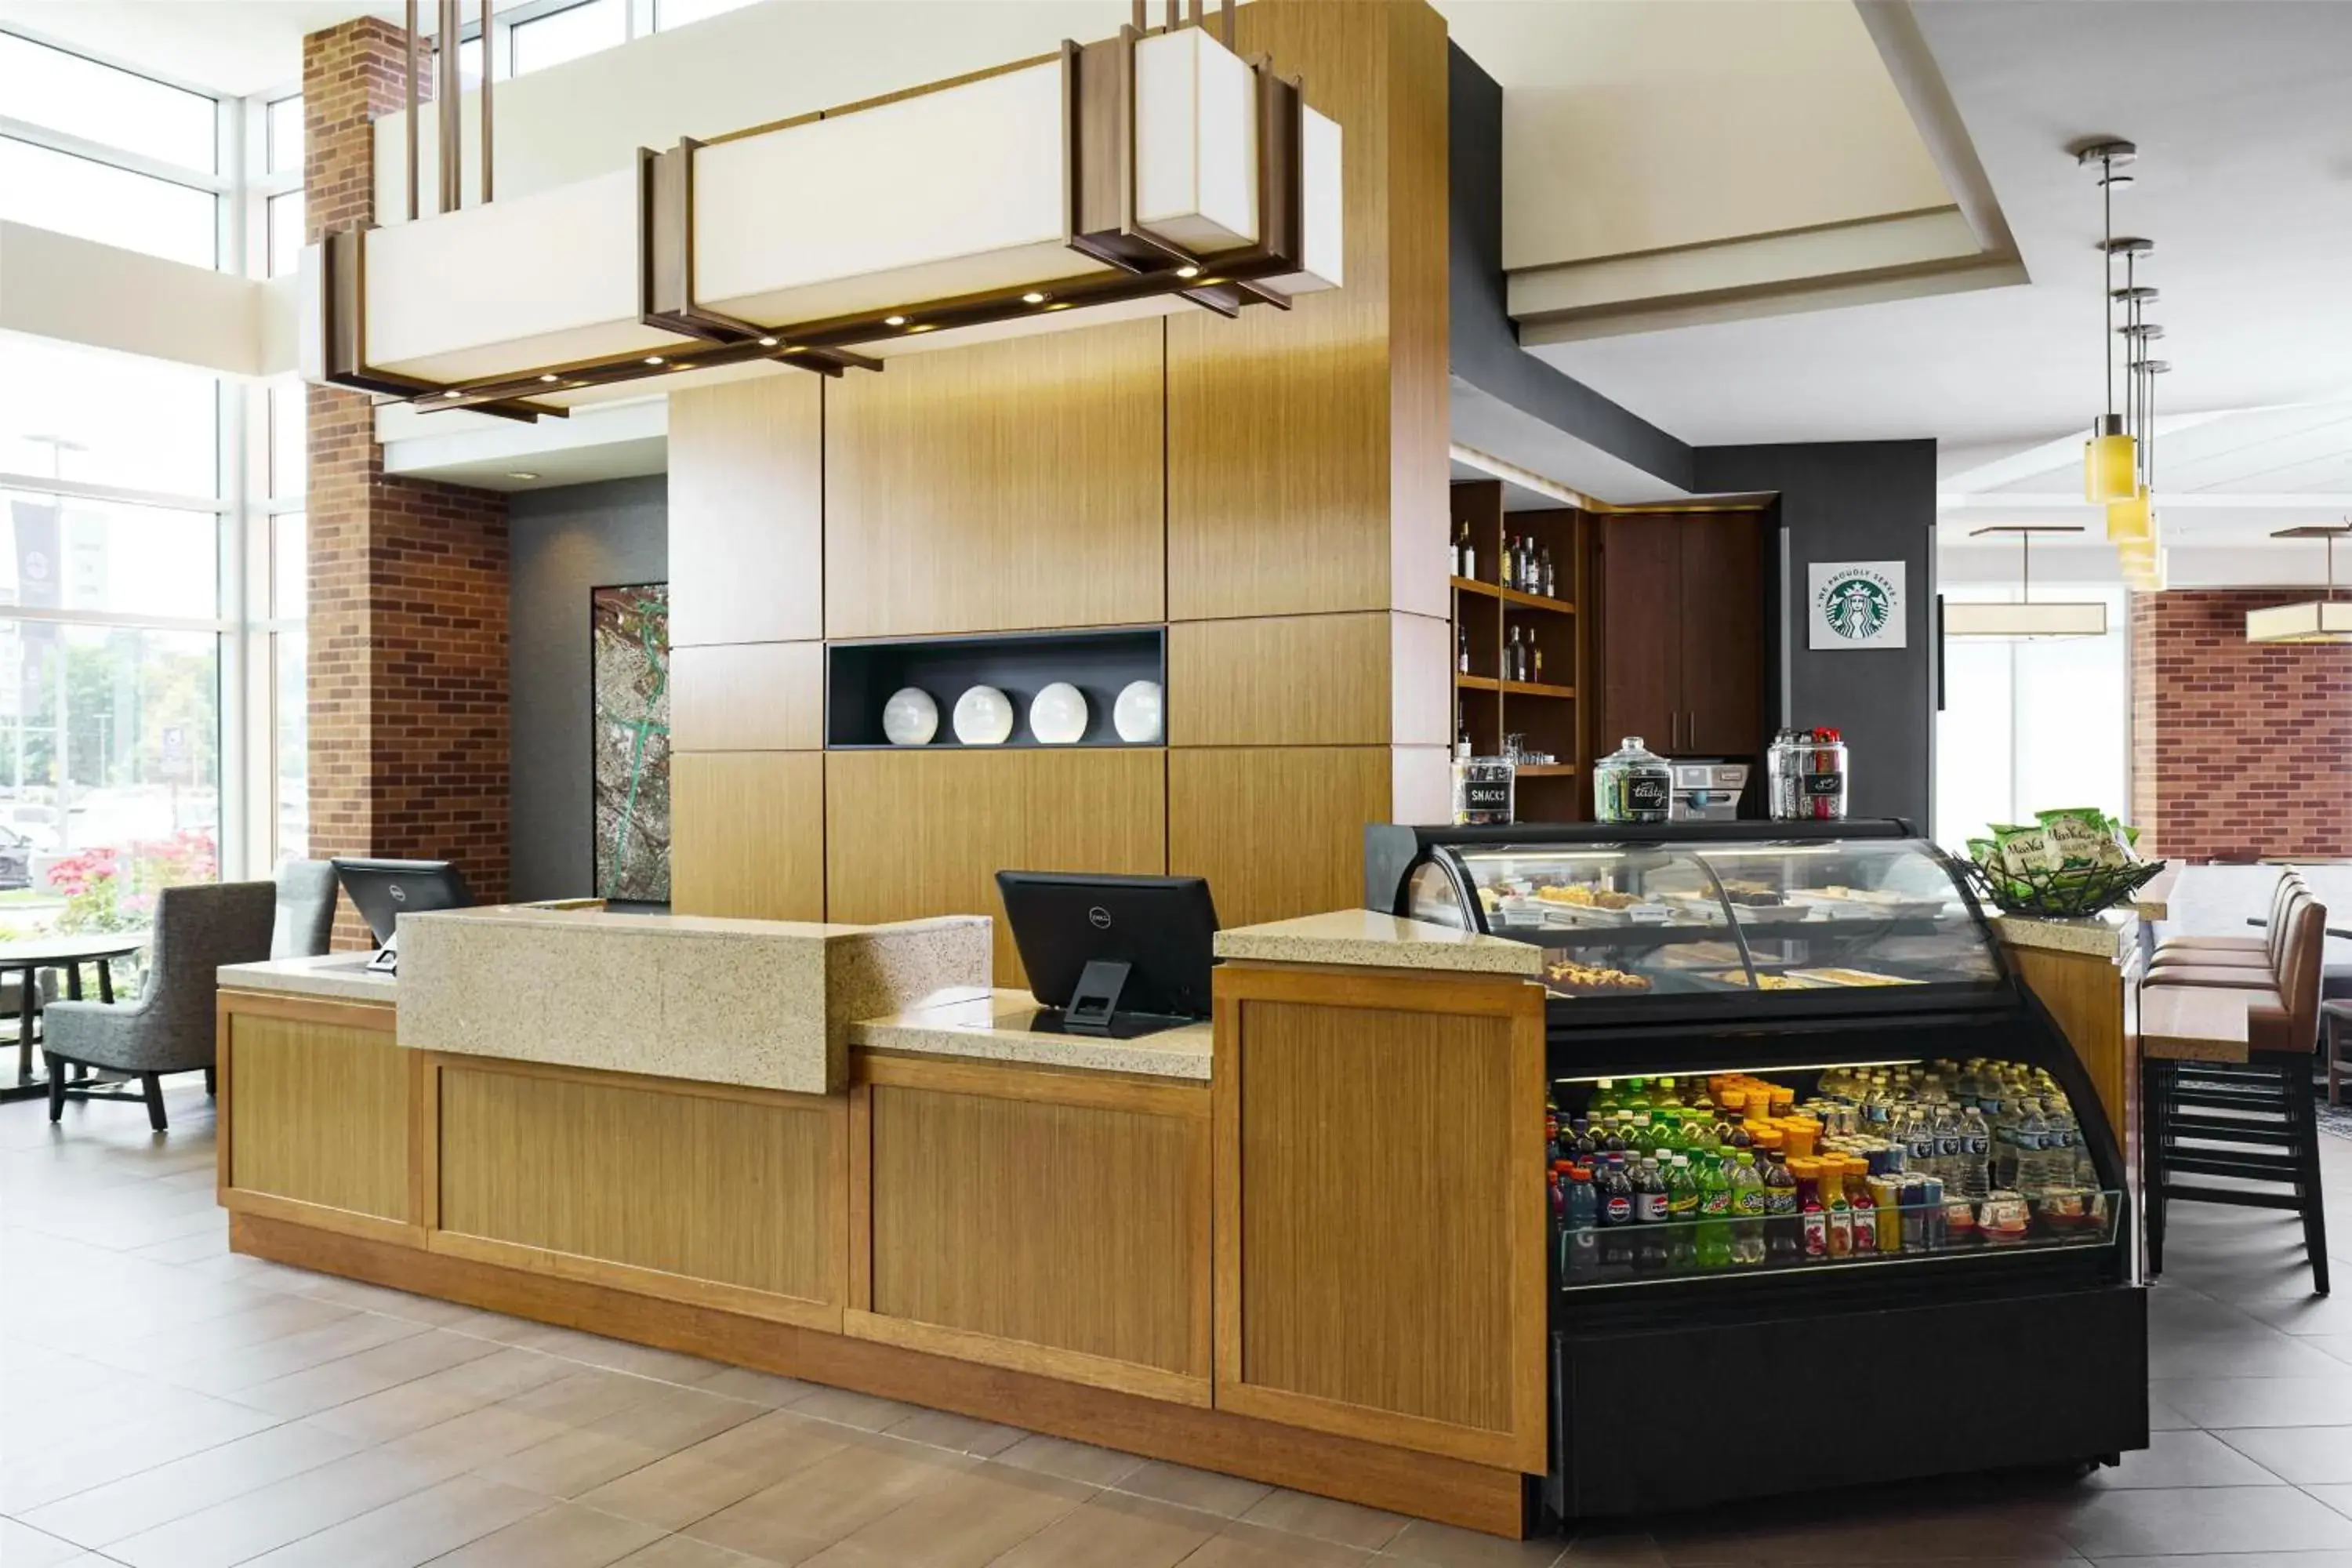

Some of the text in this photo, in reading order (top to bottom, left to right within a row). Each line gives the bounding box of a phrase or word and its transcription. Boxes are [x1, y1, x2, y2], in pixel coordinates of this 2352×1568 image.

[1819, 568, 1896, 601] WE PROUDLY SERVE
[1472, 789, 1506, 801] SNACKS
